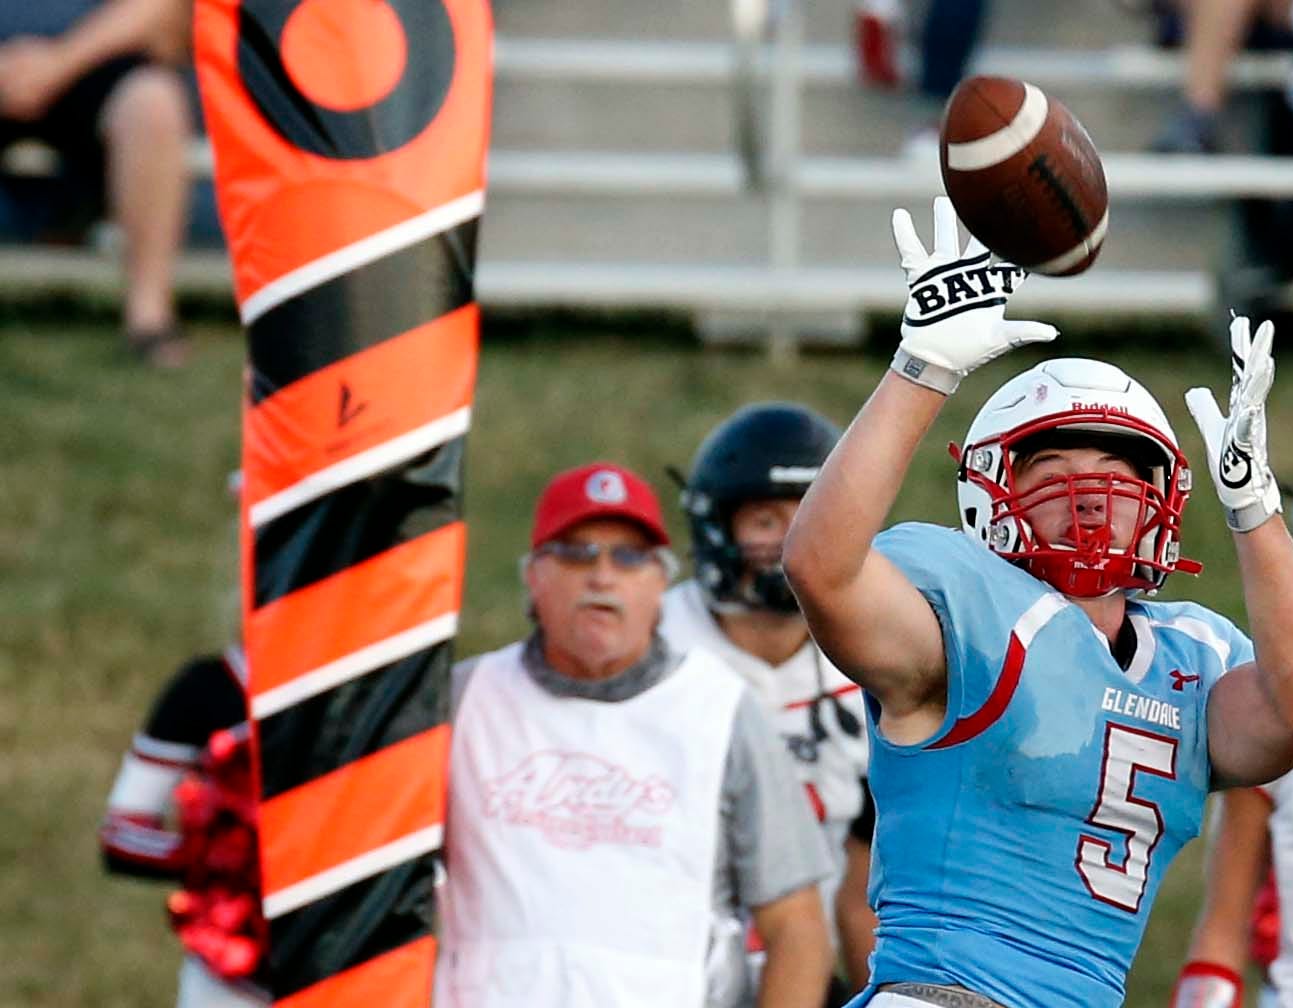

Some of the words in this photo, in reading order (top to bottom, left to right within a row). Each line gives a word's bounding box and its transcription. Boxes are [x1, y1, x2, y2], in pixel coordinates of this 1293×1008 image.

[911, 265, 1029, 315] BATT
[1101, 687, 1181, 730] GLENDALE
[1075, 720, 1179, 914] 5
